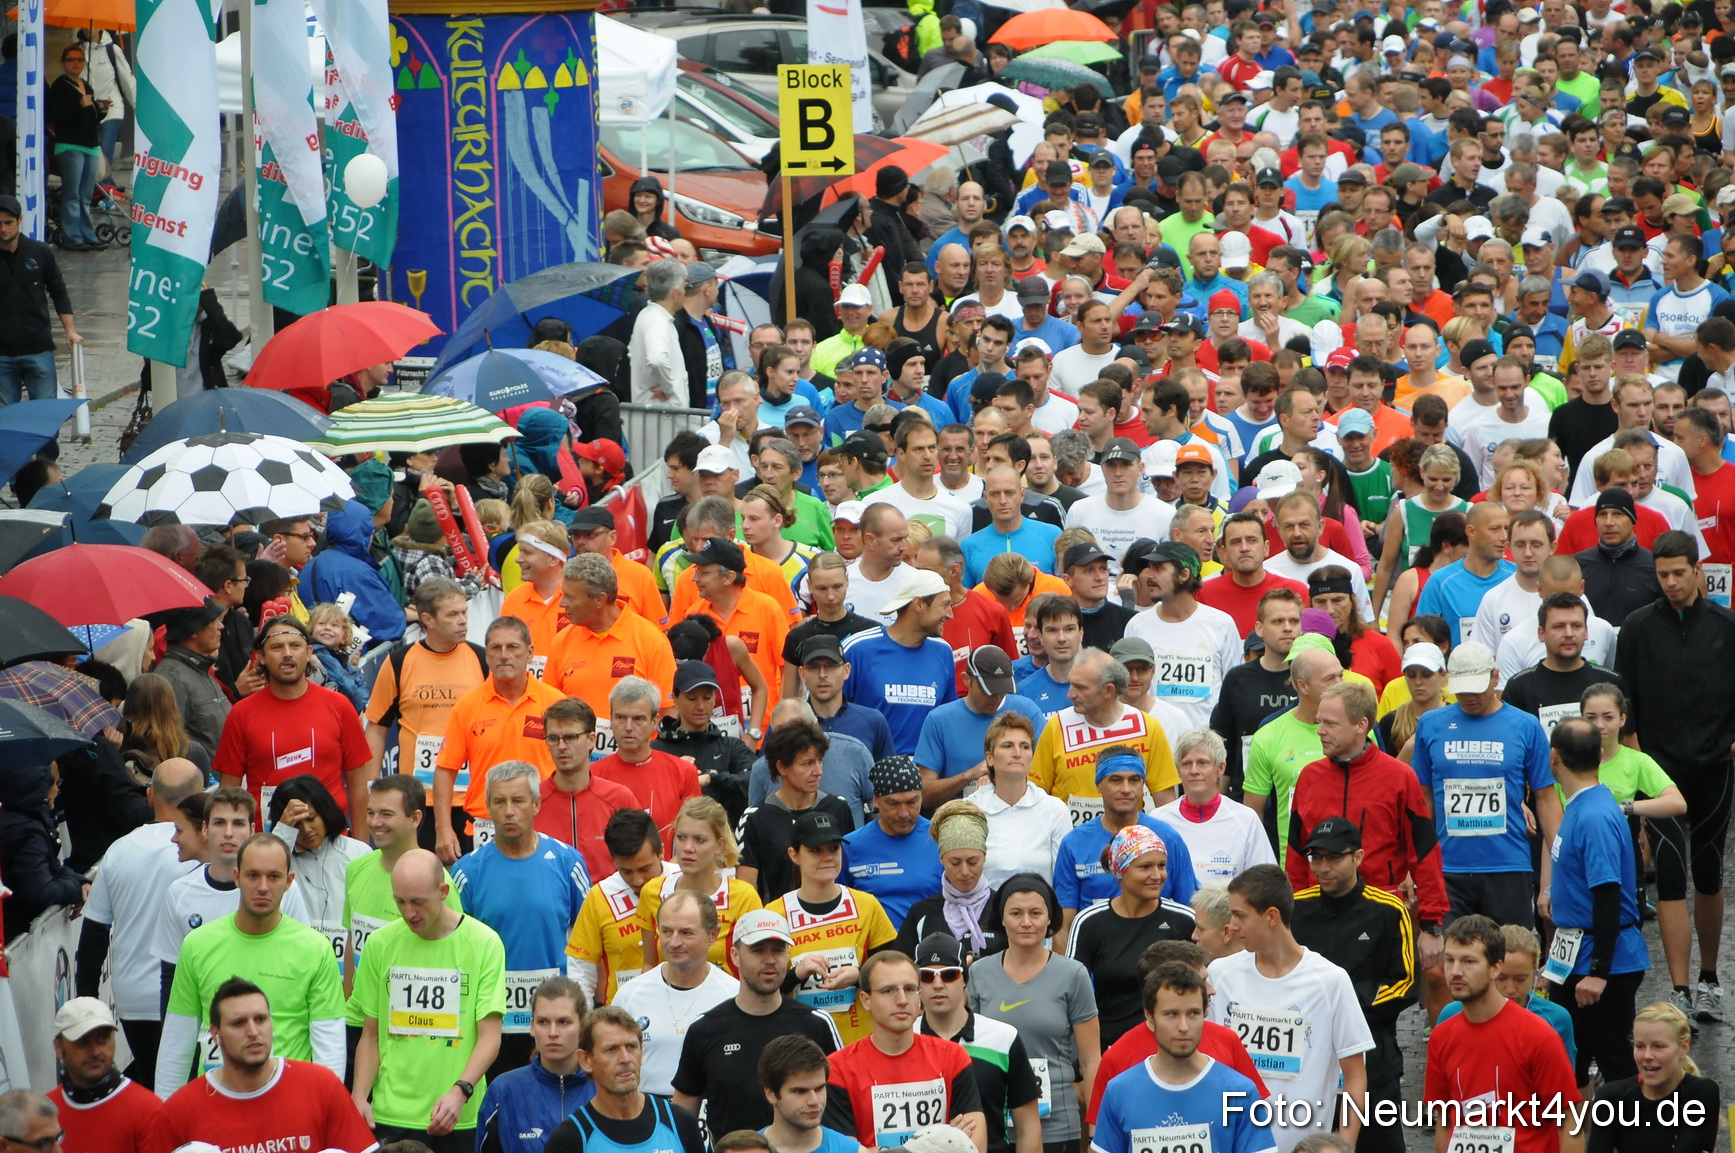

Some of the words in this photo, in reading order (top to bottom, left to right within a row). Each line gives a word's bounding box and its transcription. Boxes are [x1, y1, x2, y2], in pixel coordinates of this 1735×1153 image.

[786, 69, 843, 89] Block
[798, 98, 836, 152] B
[1161, 662, 1205, 683] 2401
[419, 688, 457, 700] OEXL
[884, 683, 937, 699] HUBER
[1170, 686, 1194, 696] Marco
[1259, 694, 1289, 707] run
[1444, 740, 1504, 755] HUBER
[1450, 792, 1500, 815] 2776
[1457, 819, 1493, 829] Matthias
[826, 922, 862, 940] BÖGL
[391, 972, 412, 981] PARTL
[413, 974, 448, 982] Neumarkt
[402, 984, 445, 1010] 148
[812, 993, 845, 1006] Andrea
[408, 1014, 434, 1026] Claus
[1232, 1011, 1255, 1020] PARTL
[1256, 1014, 1292, 1025] Neumarkt
[1237, 1023, 1294, 1053] 2461
[874, 1090, 900, 1100] PARTL
[902, 1087, 937, 1099] Neumarkt
[882, 1097, 942, 1130] 2182
[1133, 1135, 1157, 1144] PARTL
[1158, 1131, 1196, 1142] Neumarkt
[1469, 1133, 1500, 1142] Neumarkt
